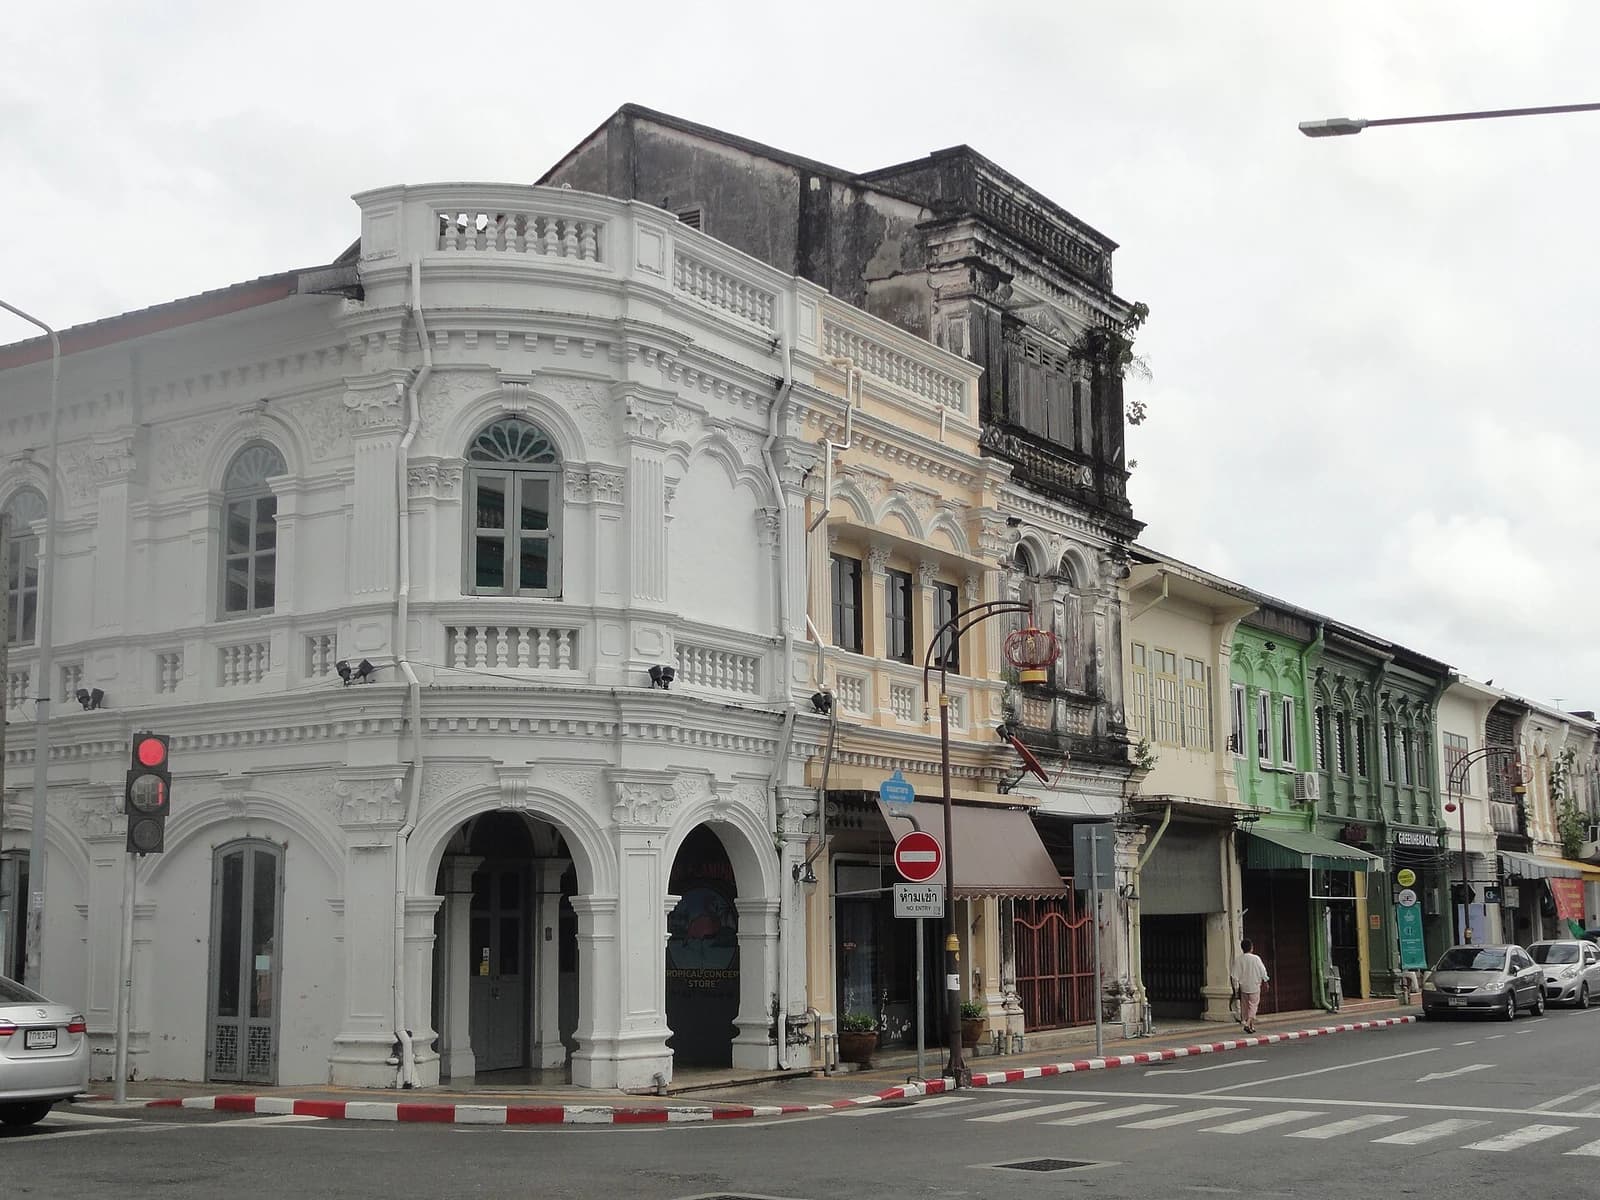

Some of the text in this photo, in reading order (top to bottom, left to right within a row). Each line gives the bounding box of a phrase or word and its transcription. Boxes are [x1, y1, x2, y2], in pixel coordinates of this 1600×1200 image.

[1398, 832, 1424, 845] GREENHEAD
[899, 887, 937, 903] ห้ามเข้า
[666, 969, 739, 979] ROPICAL CONCEP
[687, 979, 716, 988] STORE
